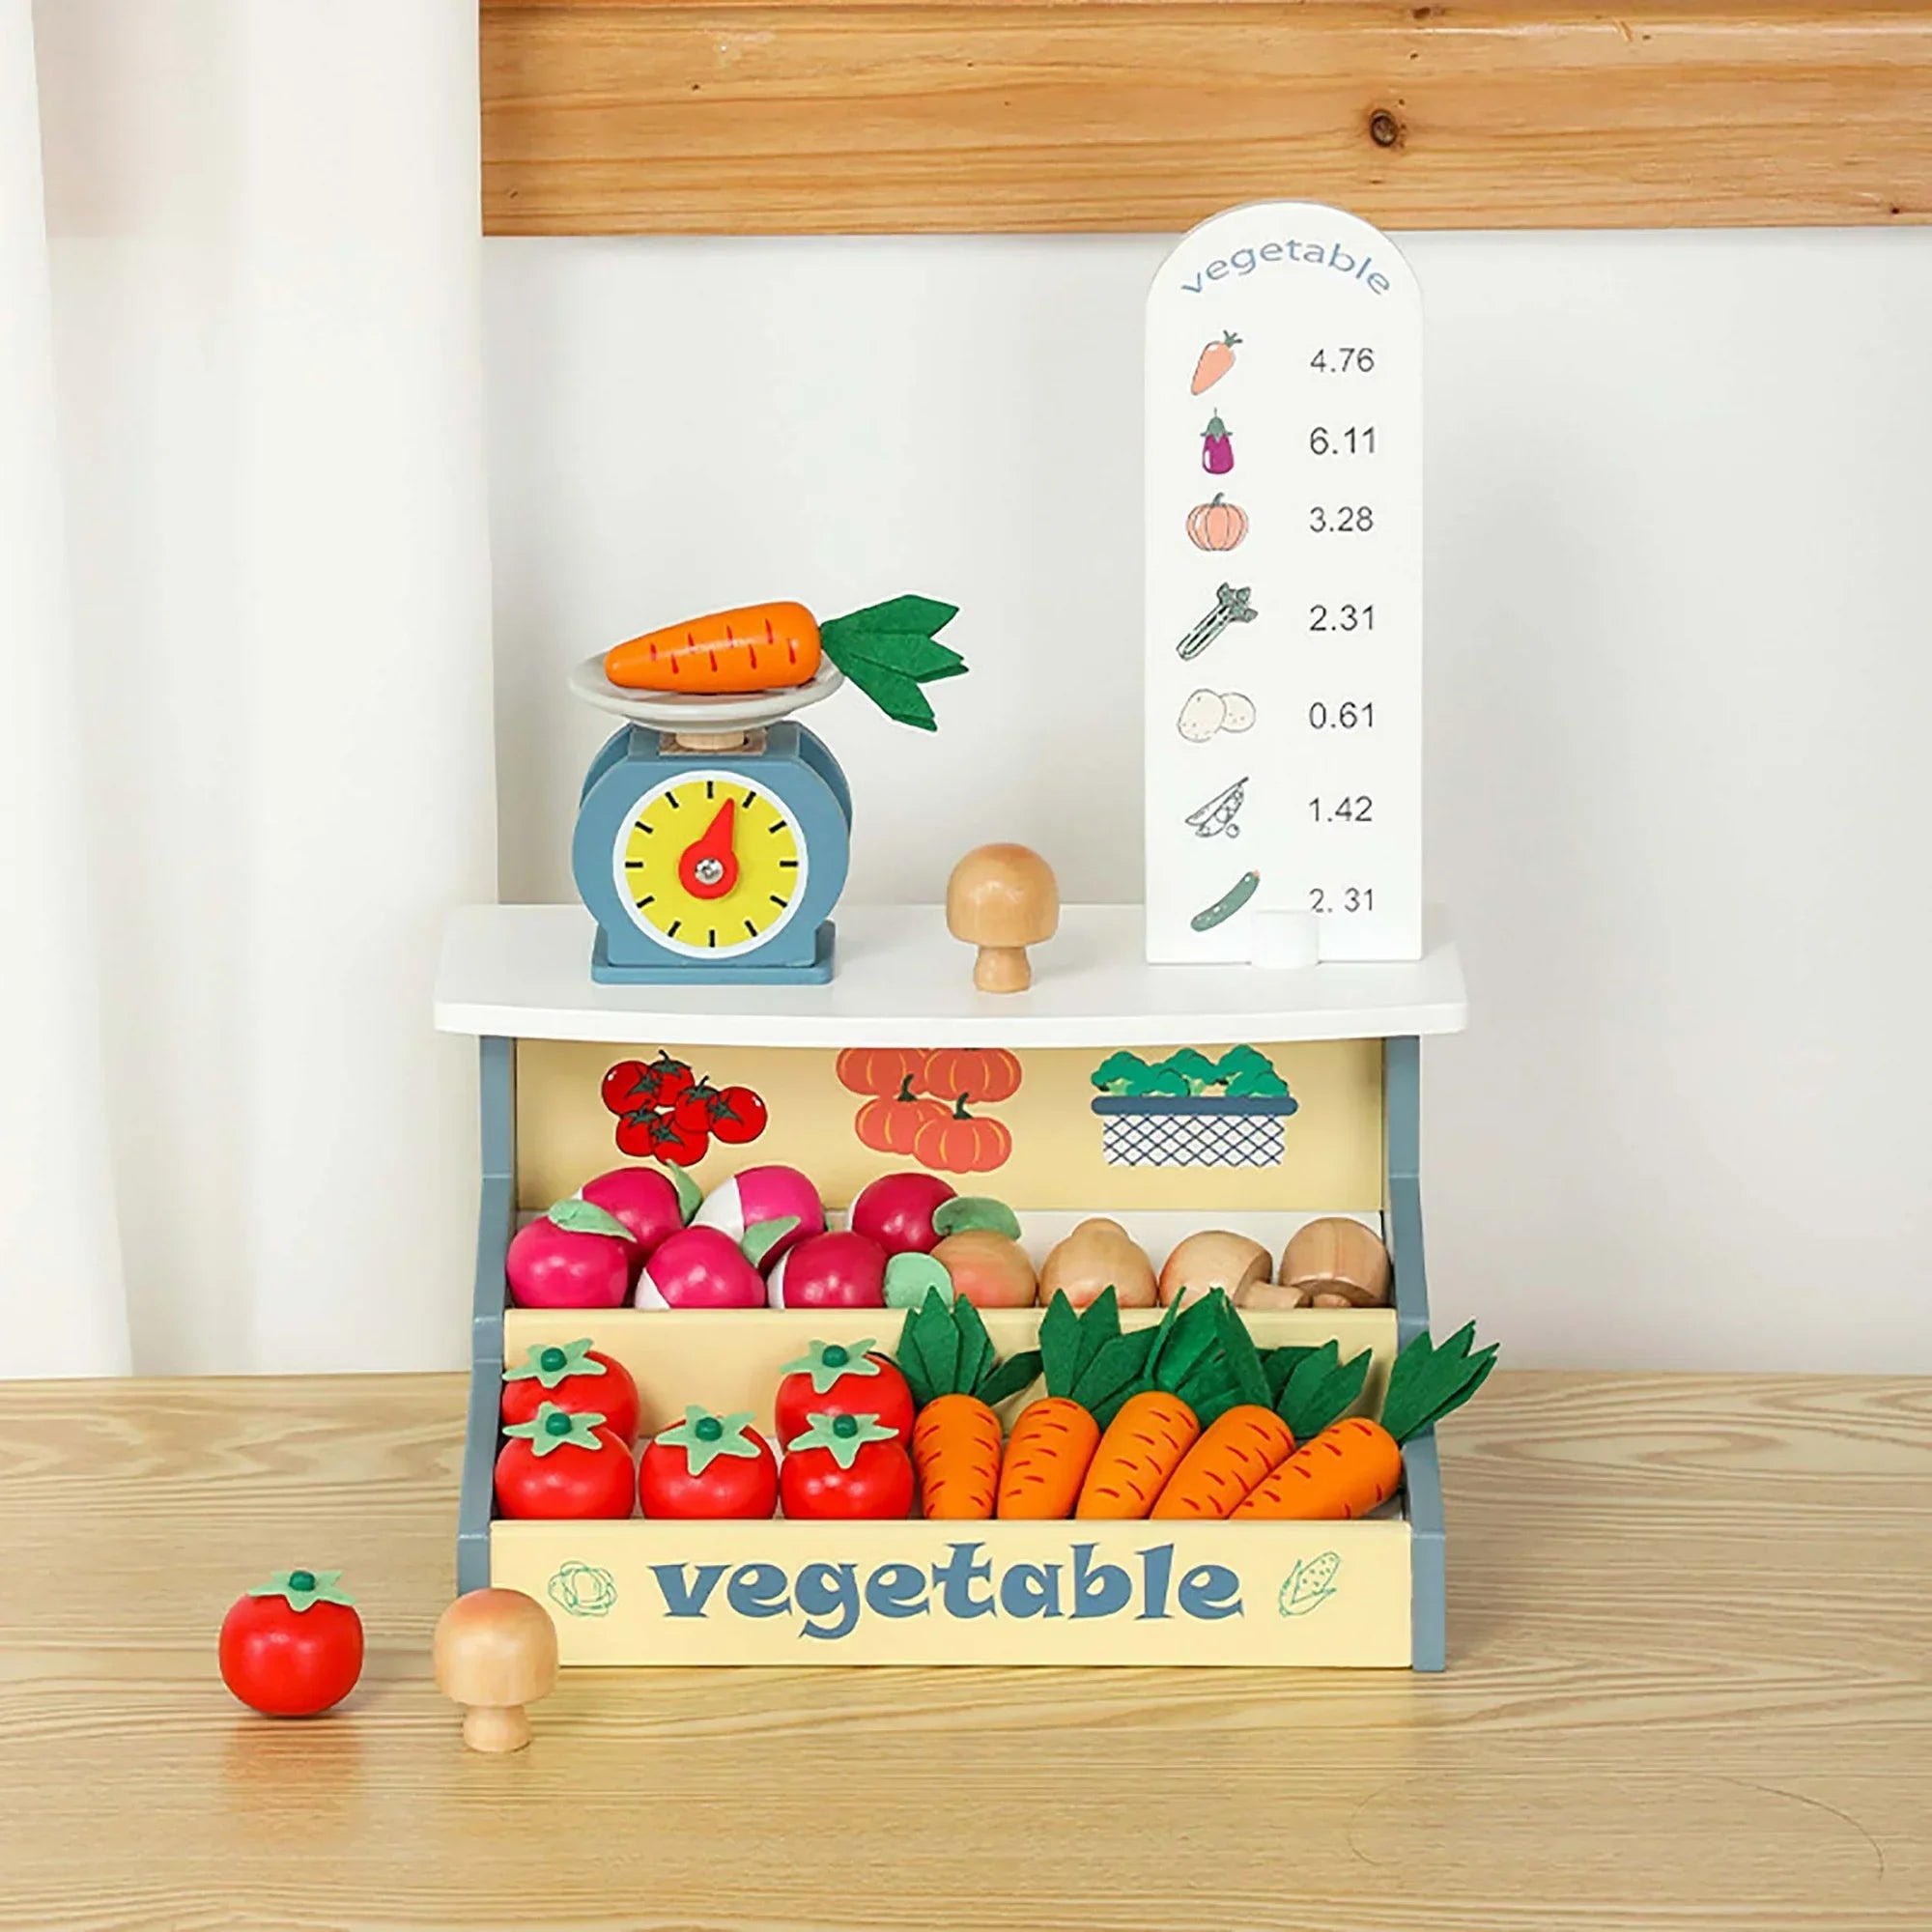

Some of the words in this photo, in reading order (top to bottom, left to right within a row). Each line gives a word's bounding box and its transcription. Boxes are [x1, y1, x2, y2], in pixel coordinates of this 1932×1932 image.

[1180, 240, 1391, 296] vegetable
[1309, 347, 1376, 374] 4.76
[1309, 426, 1376, 456] 6.11
[1309, 505, 1375, 533] 3.28
[1308, 604, 1375, 632] 2.31
[1308, 700, 1374, 729] 0.61
[1308, 795, 1374, 823] 1.42
[648, 1542, 1244, 1640] vegetable
